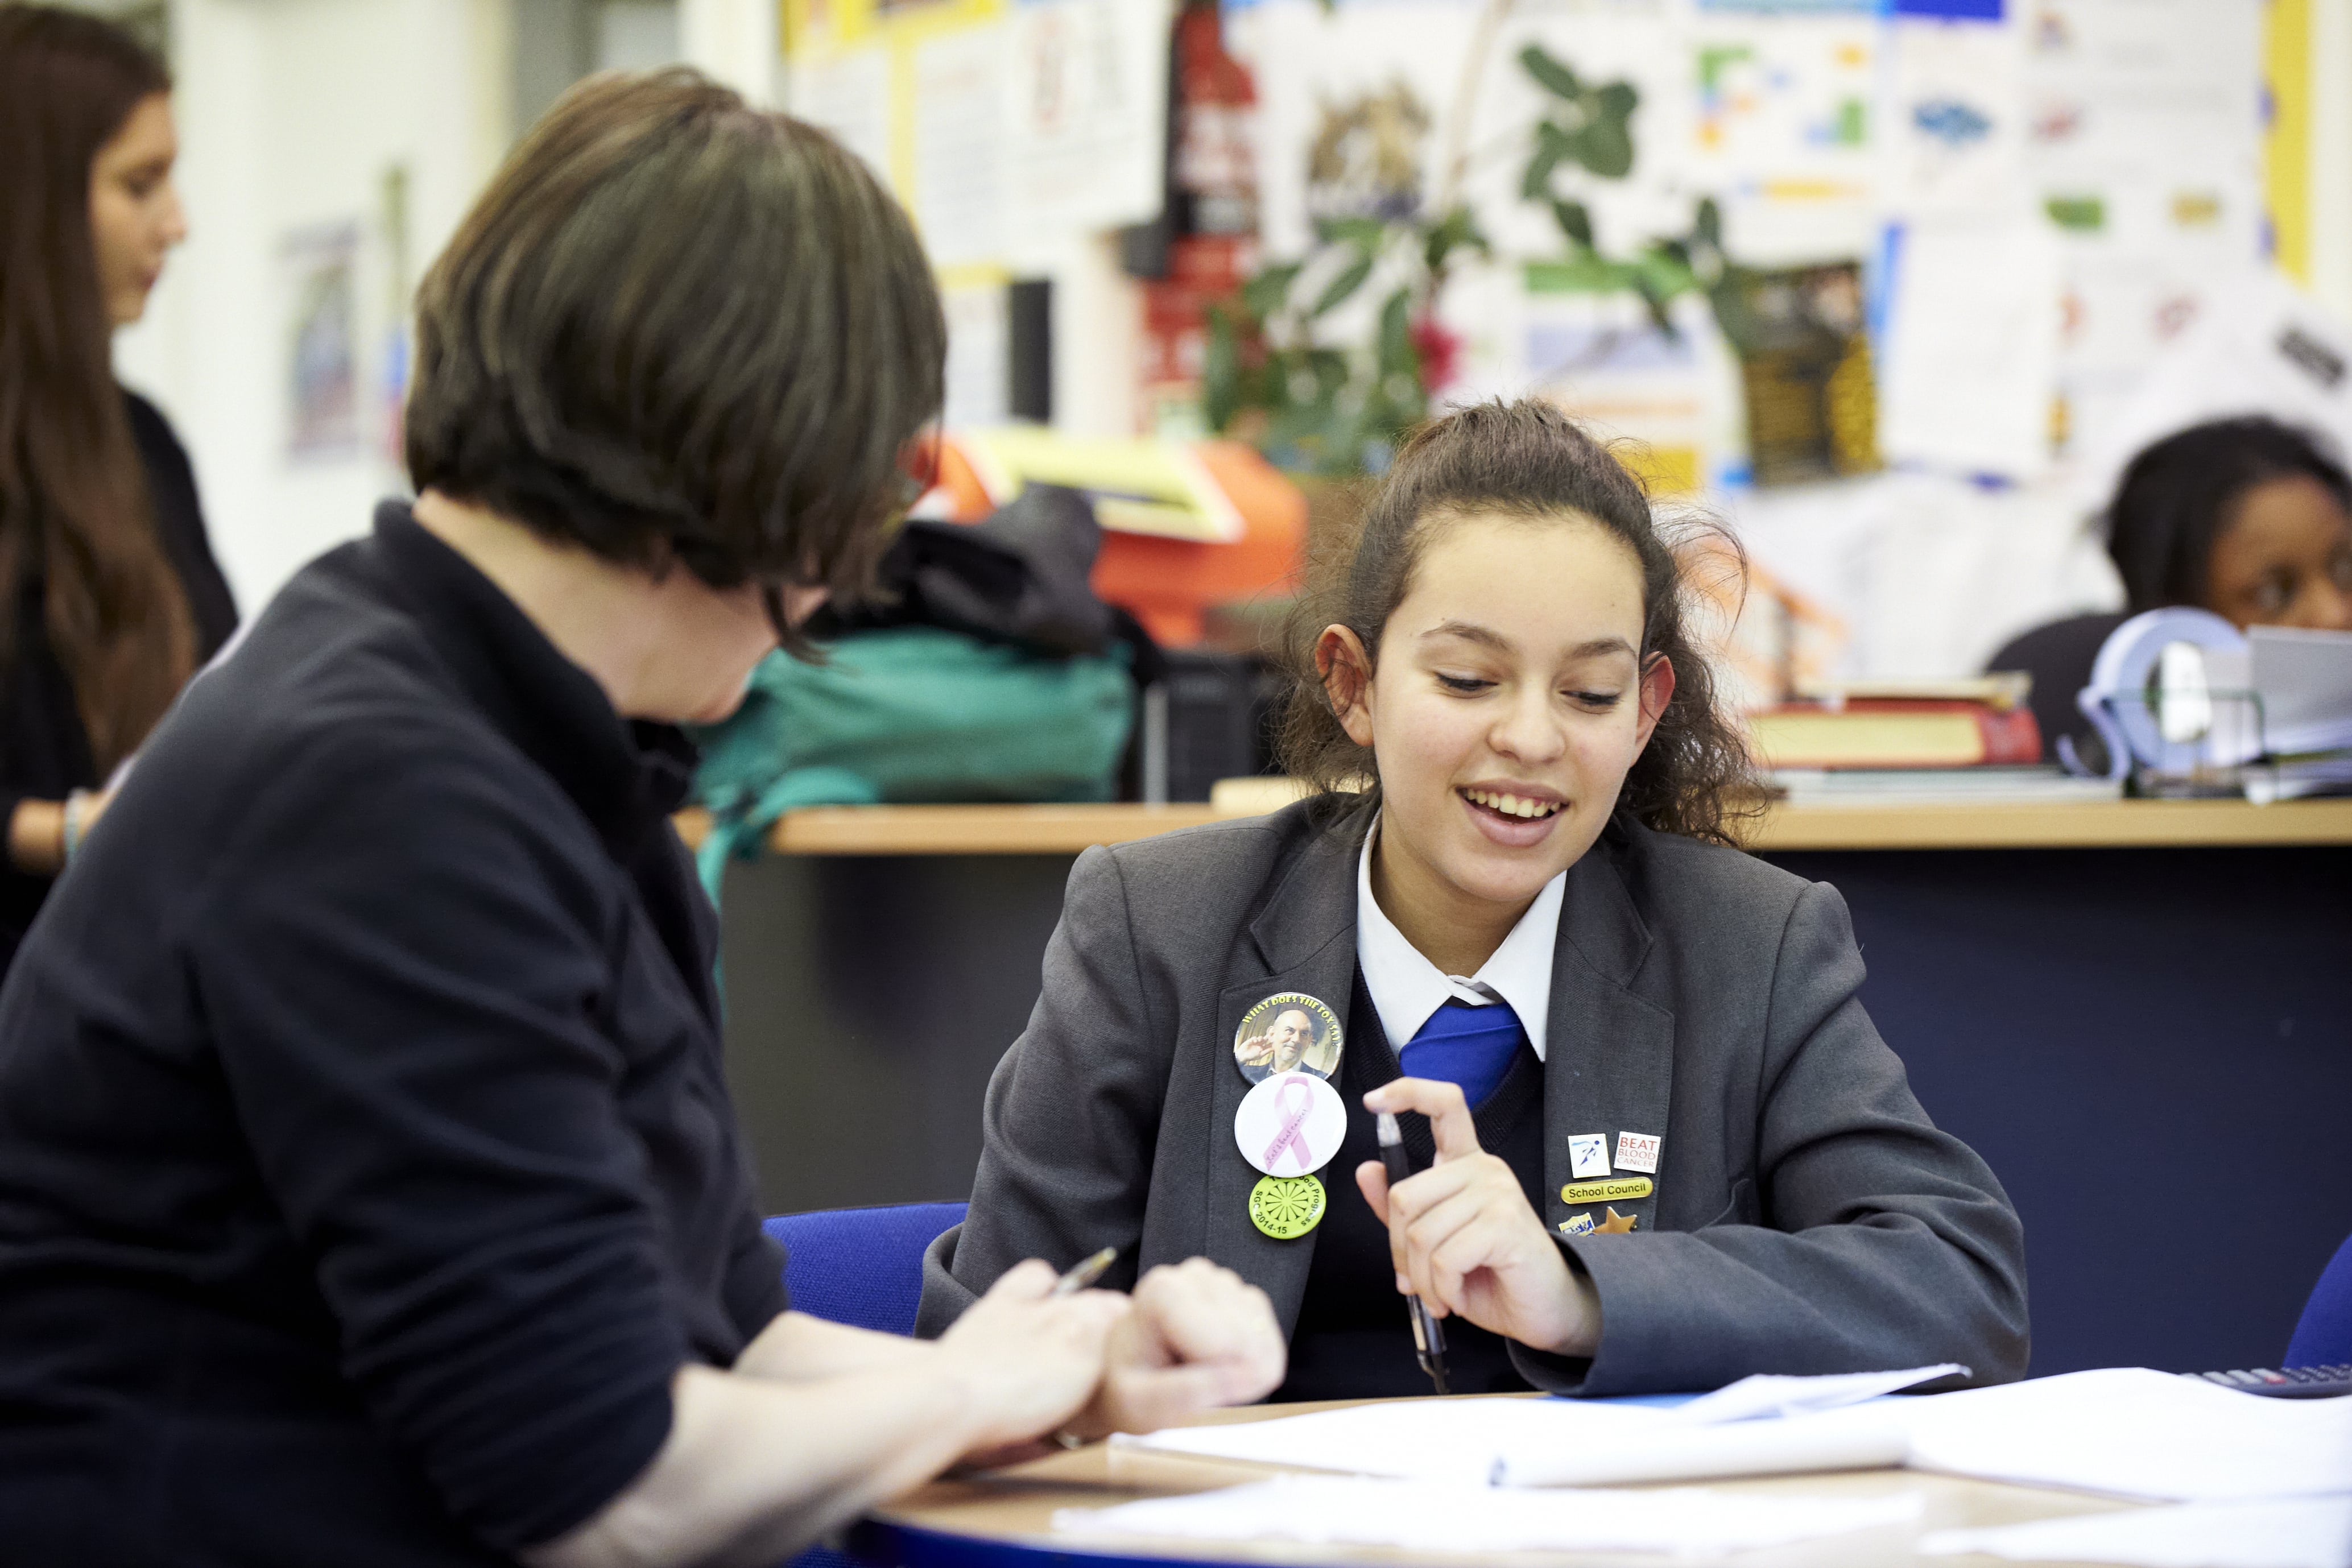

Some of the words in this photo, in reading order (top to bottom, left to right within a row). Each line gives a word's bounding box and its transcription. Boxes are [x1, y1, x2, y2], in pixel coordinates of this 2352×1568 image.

[1242, 1000, 1270, 1024] WHAT
[1271, 995, 1297, 1006] DOES
[1299, 996, 1320, 1010] THE
[1317, 1006, 1335, 1024] FOX
[1619, 1137, 1657, 1151] BEAT
[1617, 1157, 1655, 1168] CANCER
[1618, 1148, 1656, 1160] BLOOD
[1569, 1187, 1604, 1198] School
[1607, 1183, 1646, 1194] Council
[1254, 1190, 1263, 1209] SGC
[1301, 1189, 1320, 1226] Progress
[1256, 1211, 1287, 1234] 2014-15
